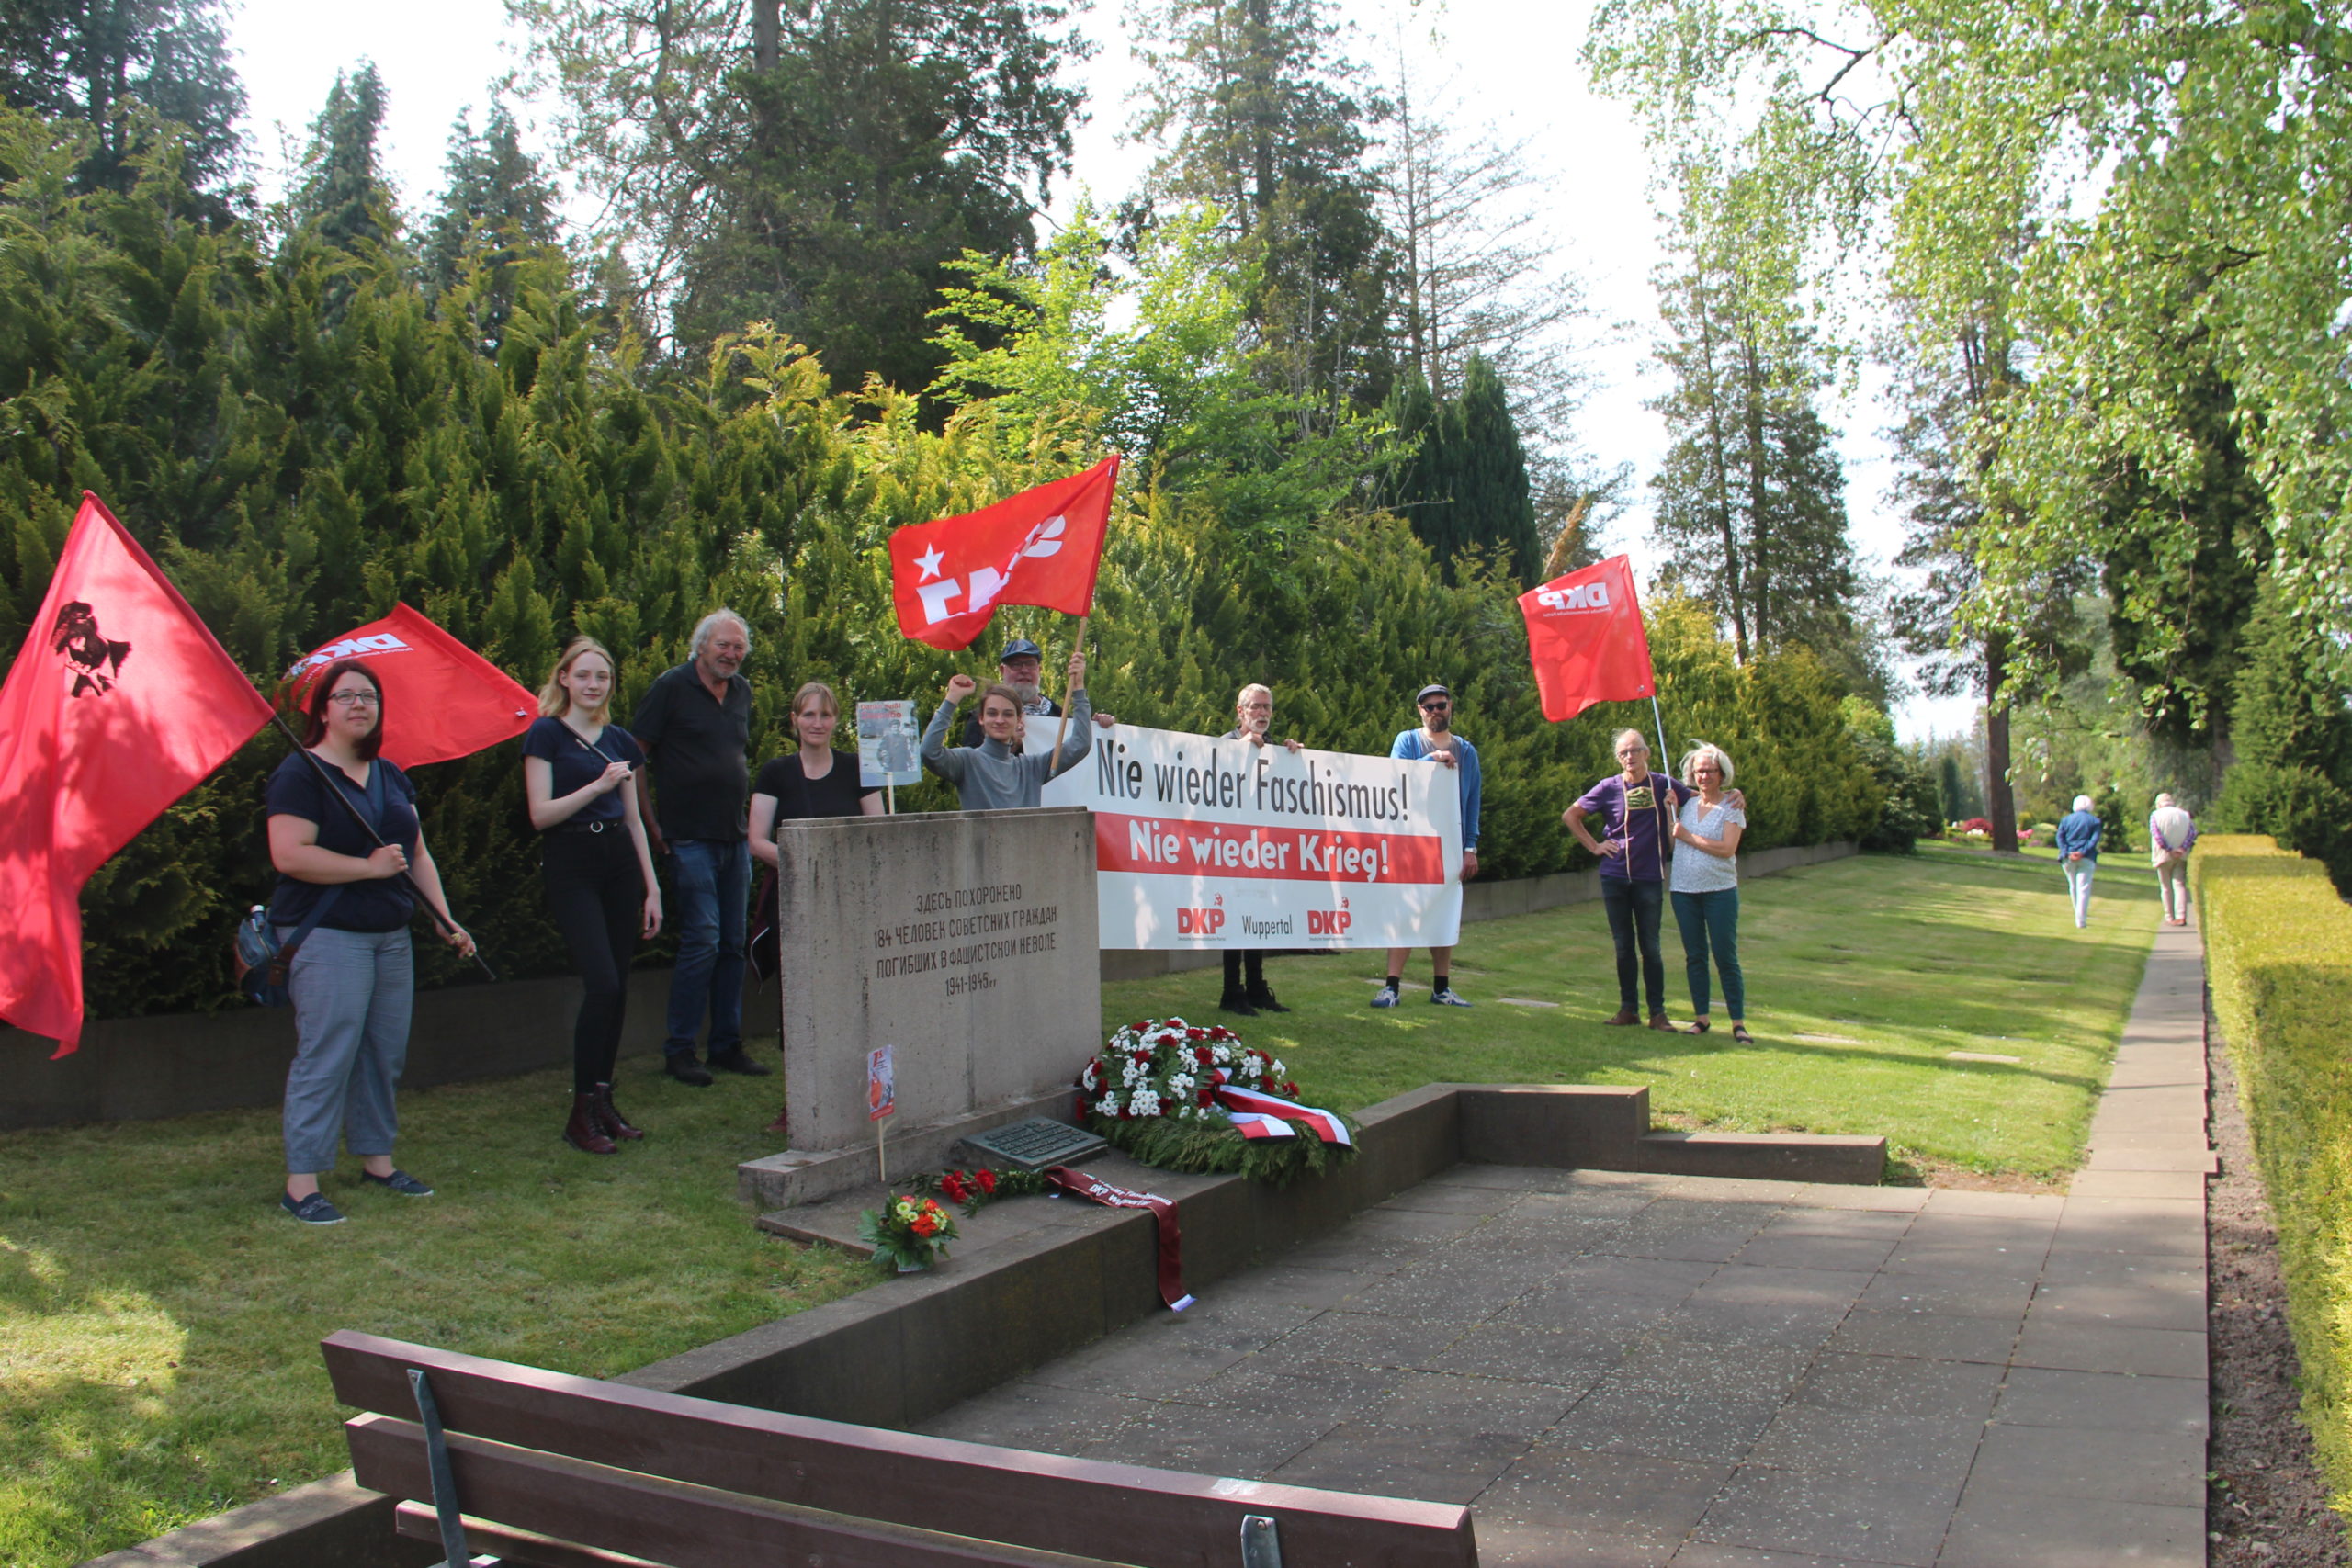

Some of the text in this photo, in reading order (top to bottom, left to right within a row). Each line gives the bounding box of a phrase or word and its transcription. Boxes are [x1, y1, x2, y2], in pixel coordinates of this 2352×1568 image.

[1096, 738, 1408, 821] Nie wieder Faschismus!
[1129, 819, 1388, 883] Nie wieder Krieg!
[917, 884, 1022, 915] ЗДЕСЬ ПОХОРОНЕНО
[875, 929, 892, 949] 184
[896, 920, 946, 945] ЧЕЛОВЕК
[1012, 906, 1057, 929] ГРАЖДАН
[1176, 908, 1225, 934] DKP
[1242, 914, 1293, 940] Wuppertal
[1307, 910, 1351, 934] DKP
[876, 951, 938, 979] ПОГИБШИХ
[941, 950, 948, 969] В
[1020, 932, 1057, 956] НЕВОЛЕ
[1089, 1183, 1110, 1197] DKP
